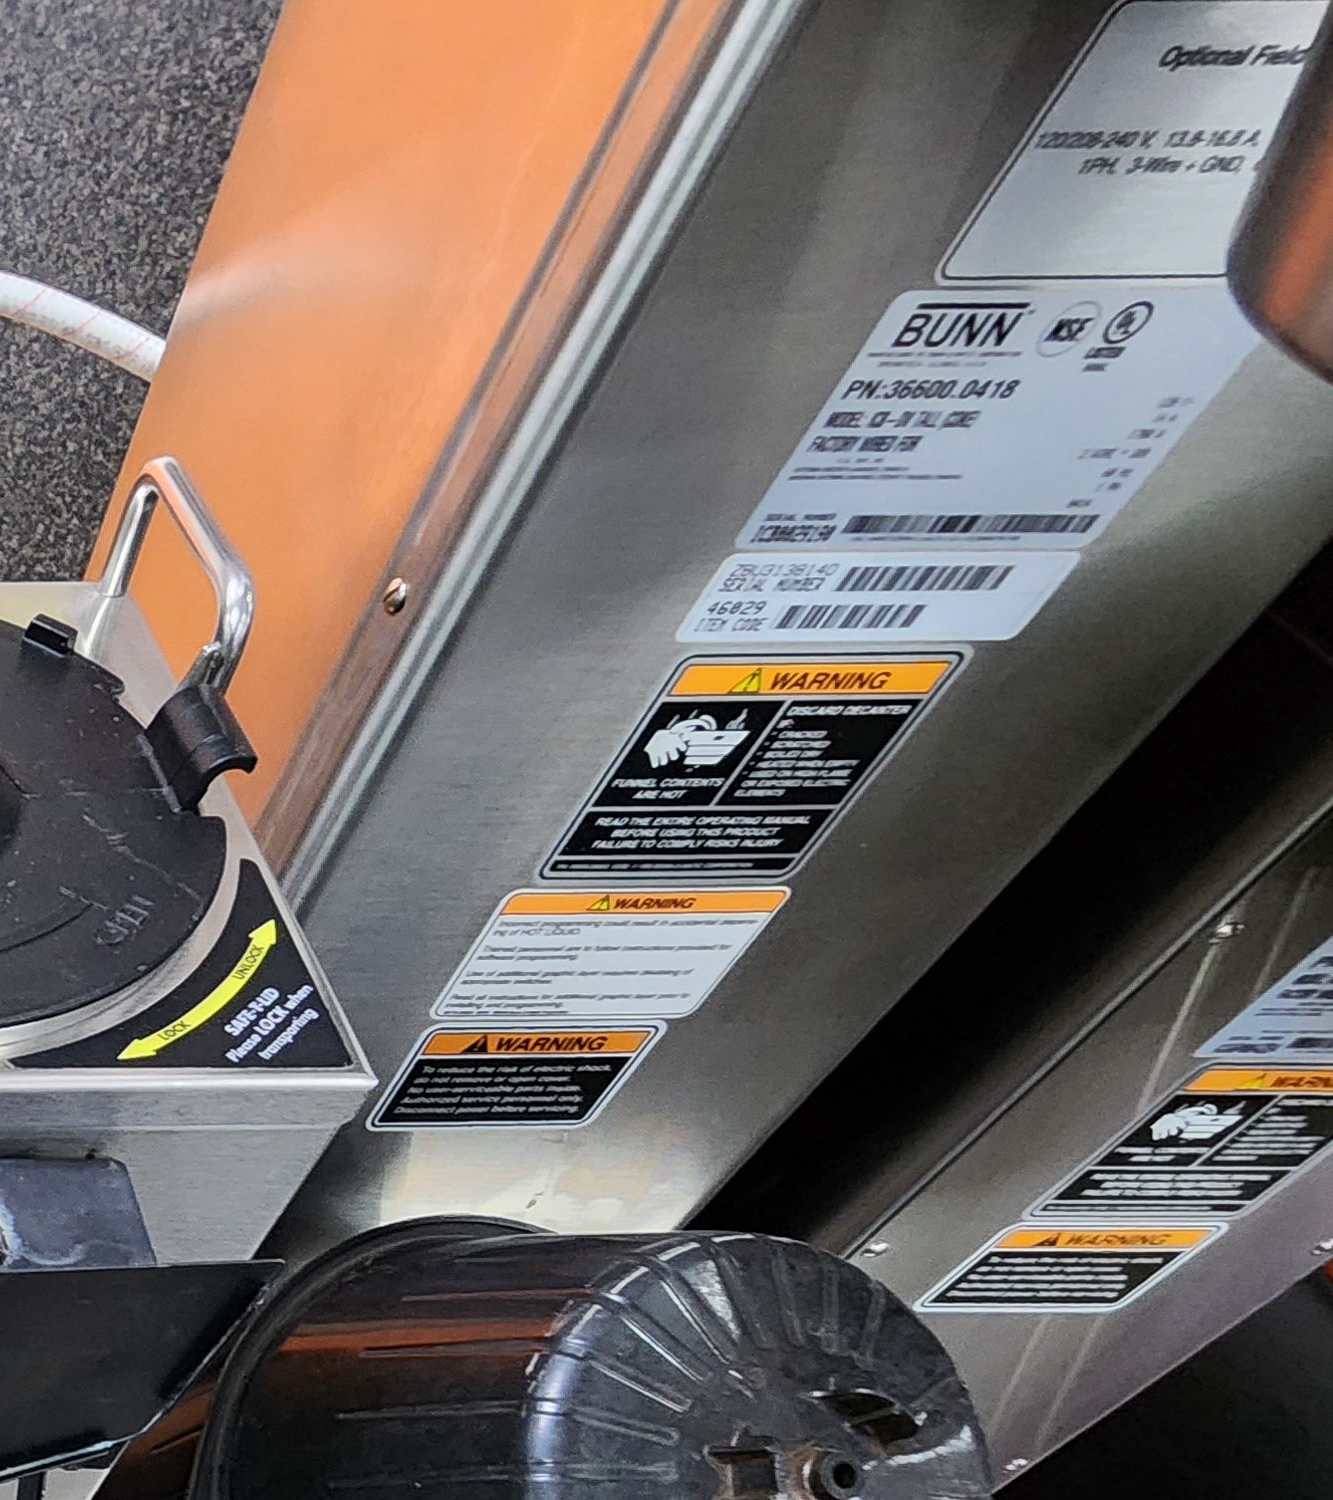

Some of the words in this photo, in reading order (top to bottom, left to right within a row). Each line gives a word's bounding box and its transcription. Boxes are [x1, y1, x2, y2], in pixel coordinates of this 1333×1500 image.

[1158, 45, 1254, 72] Optional
[892, 312, 1023, 347] BUNN
[718, 578, 764, 591] SERIAL
[773, 577, 826, 591] NUMBER
[770, 672, 892, 690] WARNING
[612, 898, 696, 909] WARNING
[233, 944, 264, 980] UNLOCK
[253, 1005, 291, 1035] LOCK
[157, 1020, 192, 1041] LOCK
[496, 1036, 608, 1050] WARNING
[1064, 1233, 1173, 1245] WARNING
